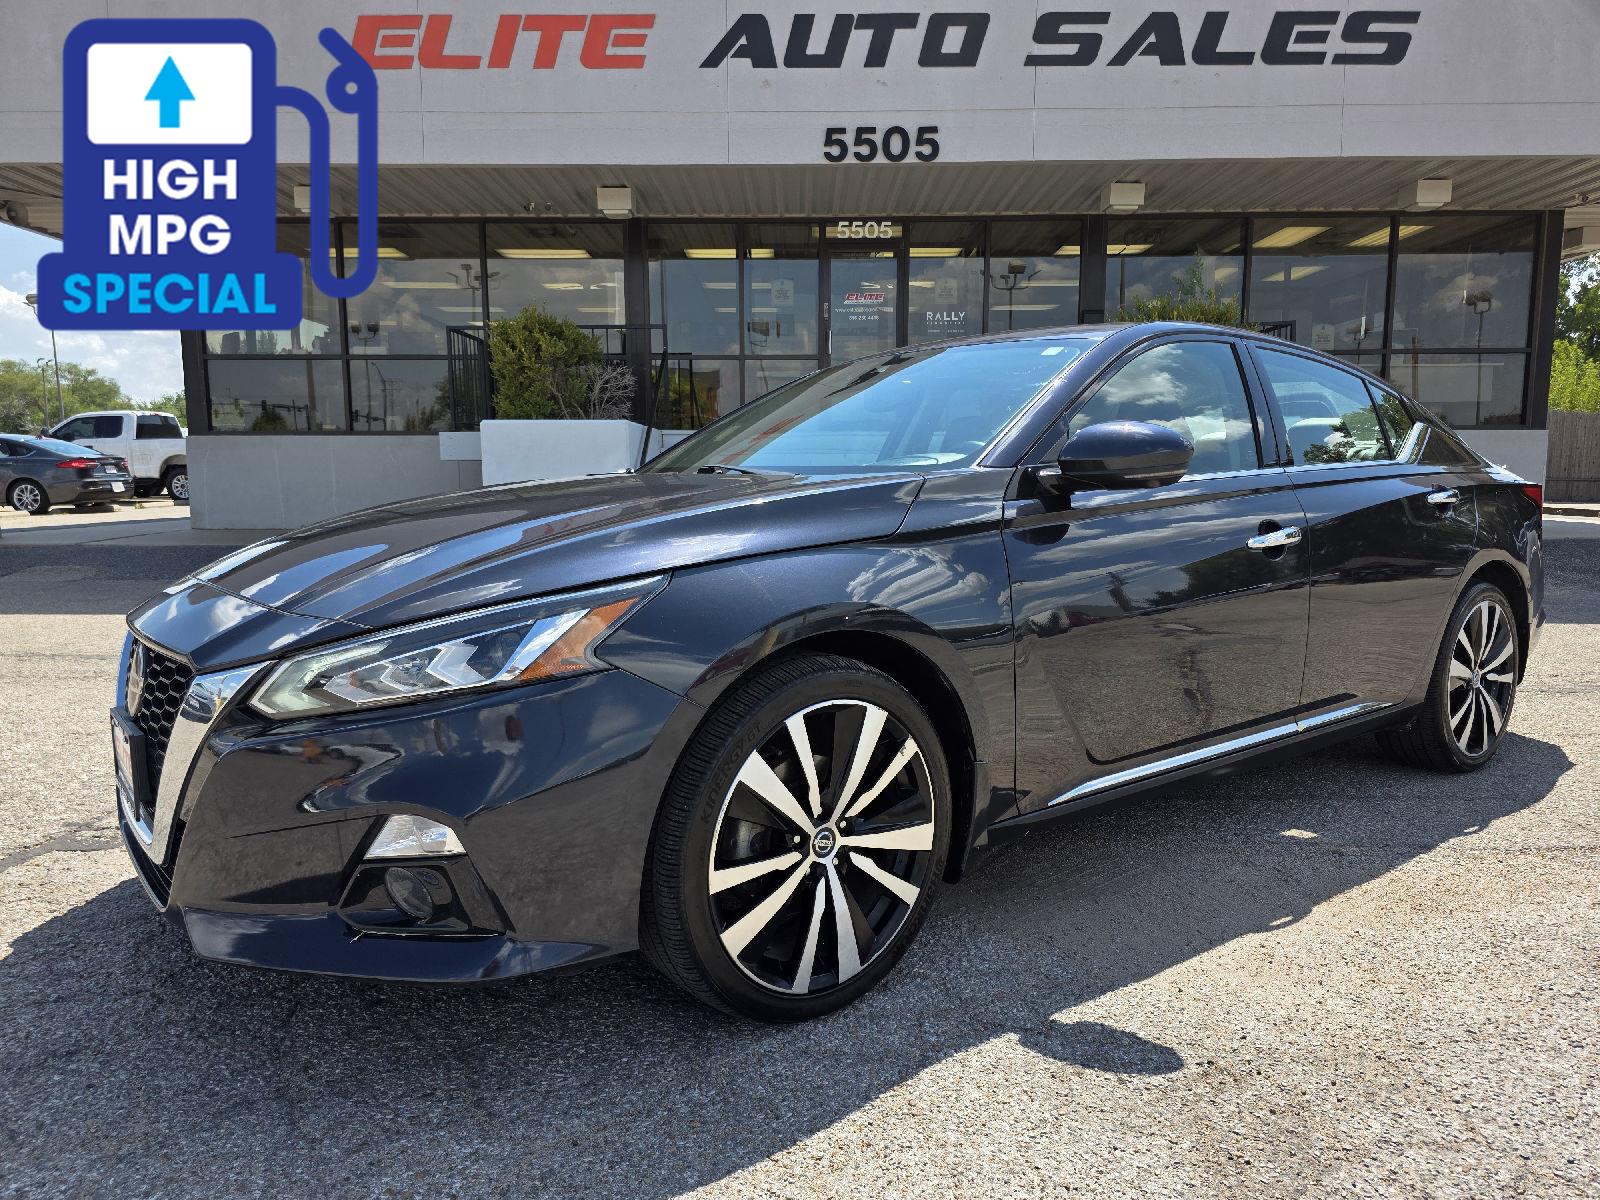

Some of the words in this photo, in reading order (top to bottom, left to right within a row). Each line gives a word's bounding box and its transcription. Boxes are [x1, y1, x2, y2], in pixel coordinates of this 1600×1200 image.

[351, 14, 655, 70] ELITE
[699, 12, 991, 69] AUTO
[1024, 10, 1421, 68] SALES
[823, 125, 940, 163] 5505
[836, 221, 893, 239] 5505
[846, 293, 885, 301] ELITE
[926, 311, 966, 321] RALLY
